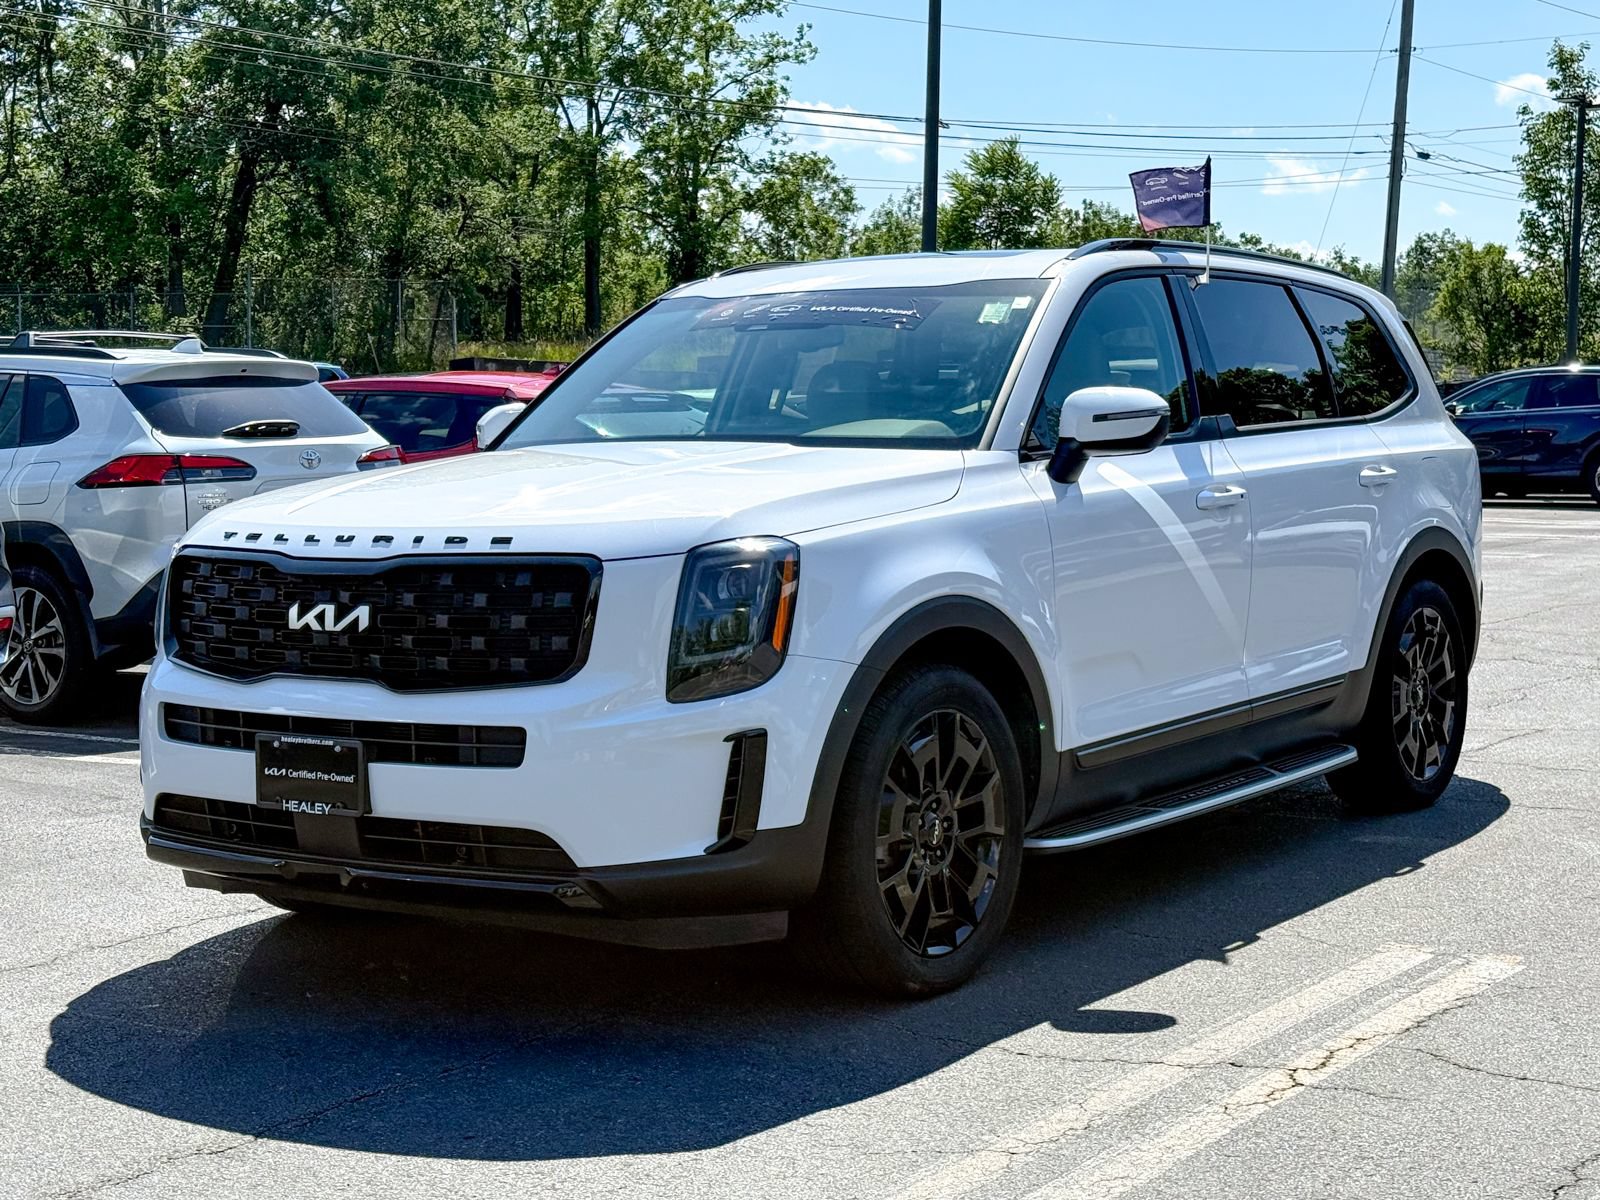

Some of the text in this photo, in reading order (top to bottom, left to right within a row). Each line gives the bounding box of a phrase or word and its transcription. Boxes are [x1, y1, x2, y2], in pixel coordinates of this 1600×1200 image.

[869, 306, 914, 315] Pre-Owned
[224, 531, 513, 546] TELLURIDE
[288, 601, 370, 632] KIA
[280, 735, 334, 746] healeybrothers.com
[264, 767, 354, 783] KIA Certified Pre-Owned
[282, 799, 332, 815] HEALEY
